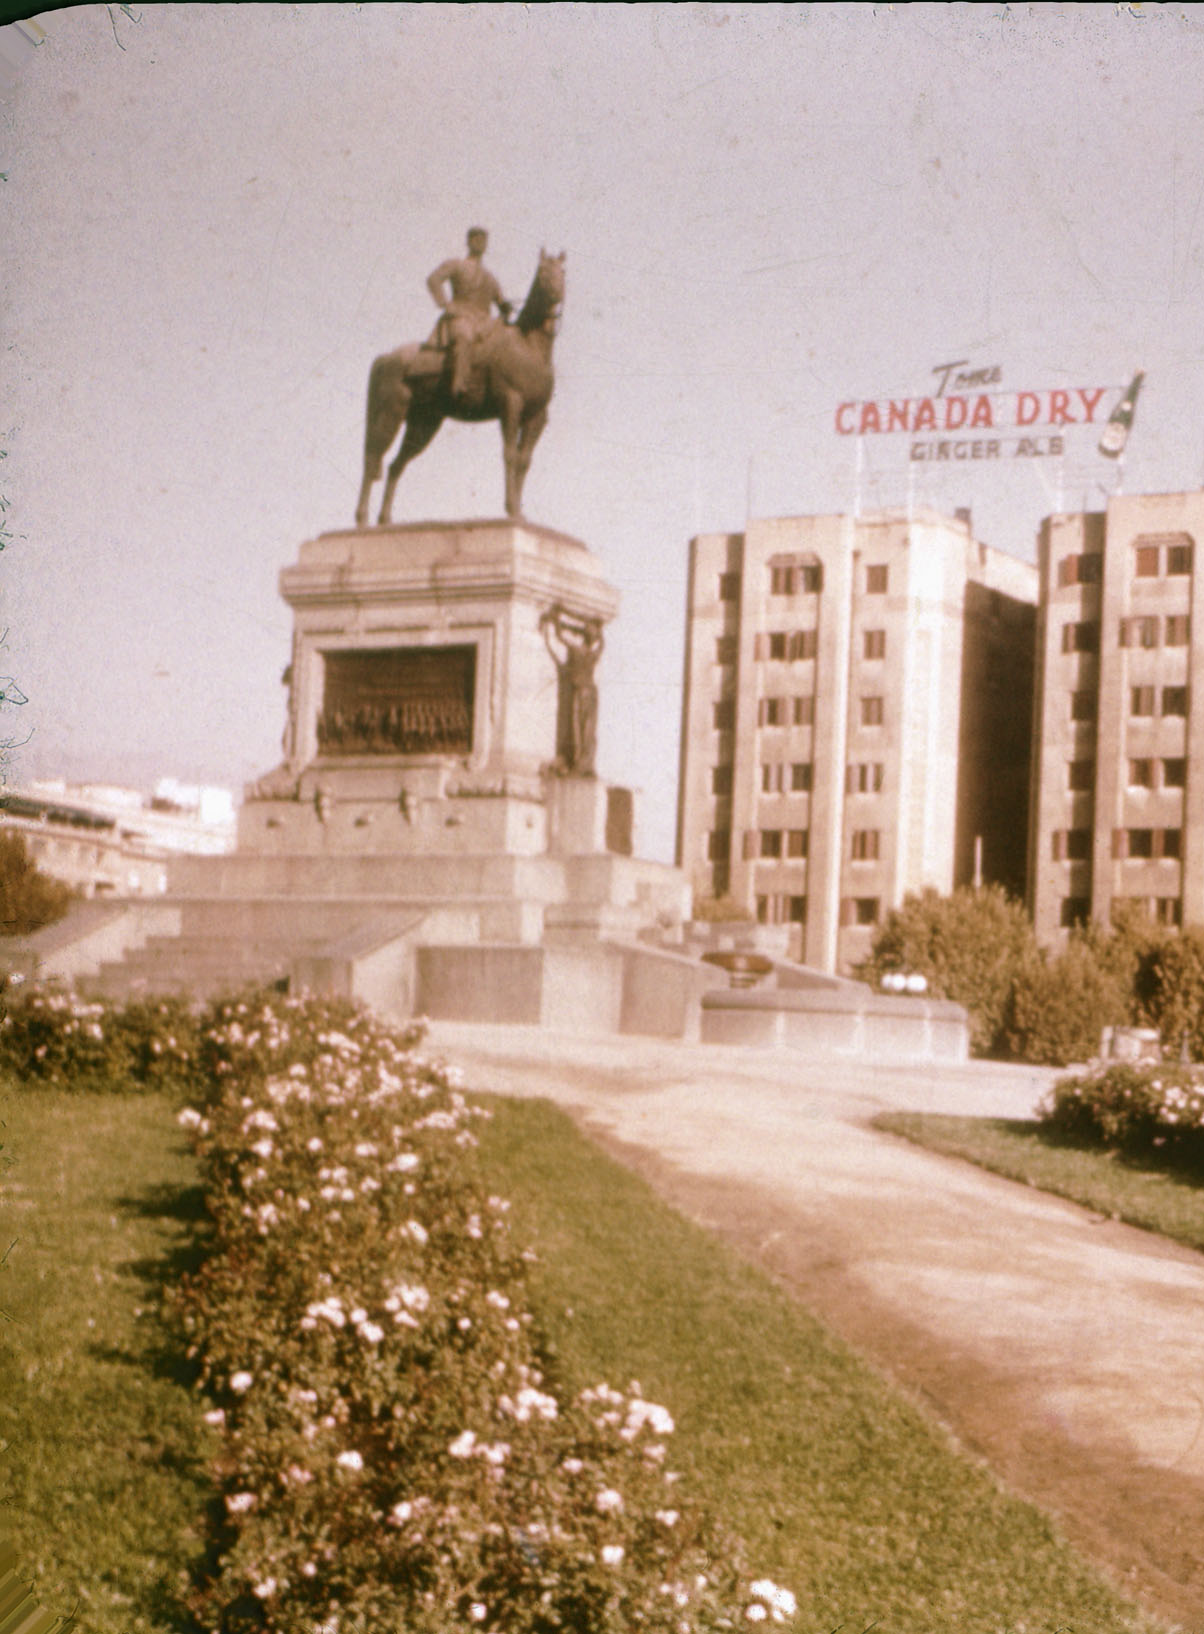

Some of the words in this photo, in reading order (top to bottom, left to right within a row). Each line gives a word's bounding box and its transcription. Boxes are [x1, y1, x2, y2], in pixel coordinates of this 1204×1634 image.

[835, 394, 994, 436] CANADA
[1015, 387, 1106, 426] DRY
[909, 439, 1001, 461] GINGER
